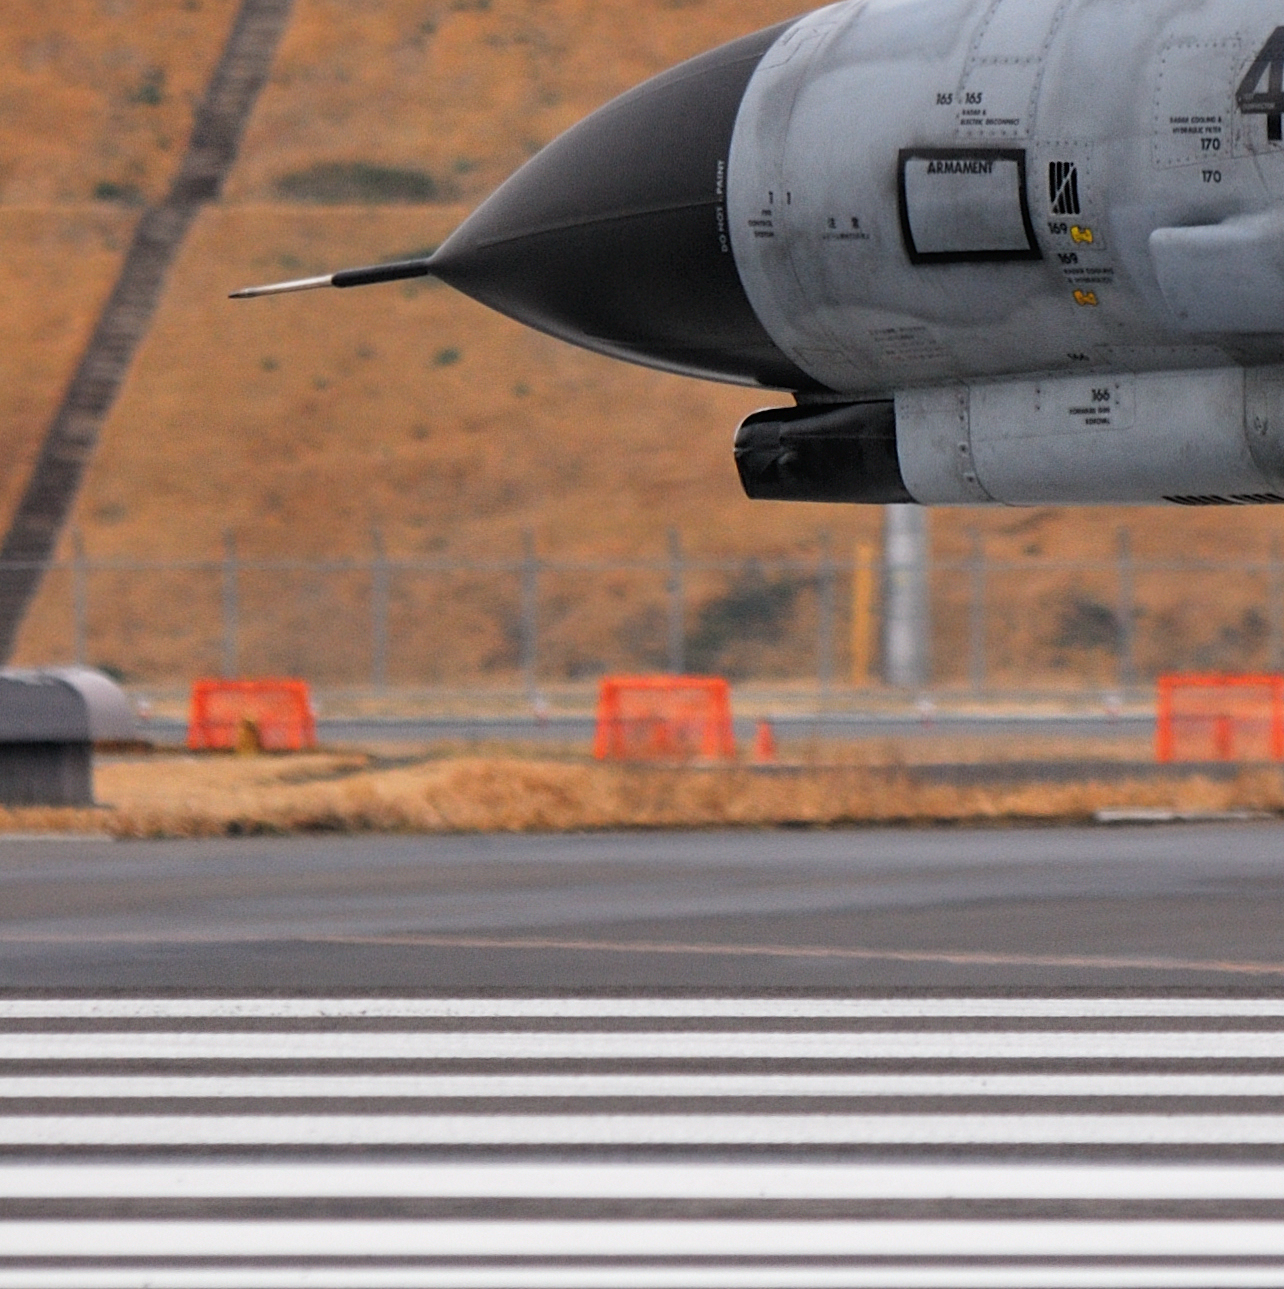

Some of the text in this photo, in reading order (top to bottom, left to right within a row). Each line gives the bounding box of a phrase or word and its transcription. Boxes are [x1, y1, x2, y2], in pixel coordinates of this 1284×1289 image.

[935, 93, 954, 106] 165
[964, 92, 983, 105] 165
[1200, 137, 1221, 152] 170
[927, 160, 994, 175] ARMAMENT
[1201, 169, 1222, 183] 170
[1047, 222, 1068, 235] 169
[1057, 252, 1079, 265] 169
[1091, 388, 1111, 402] 166
